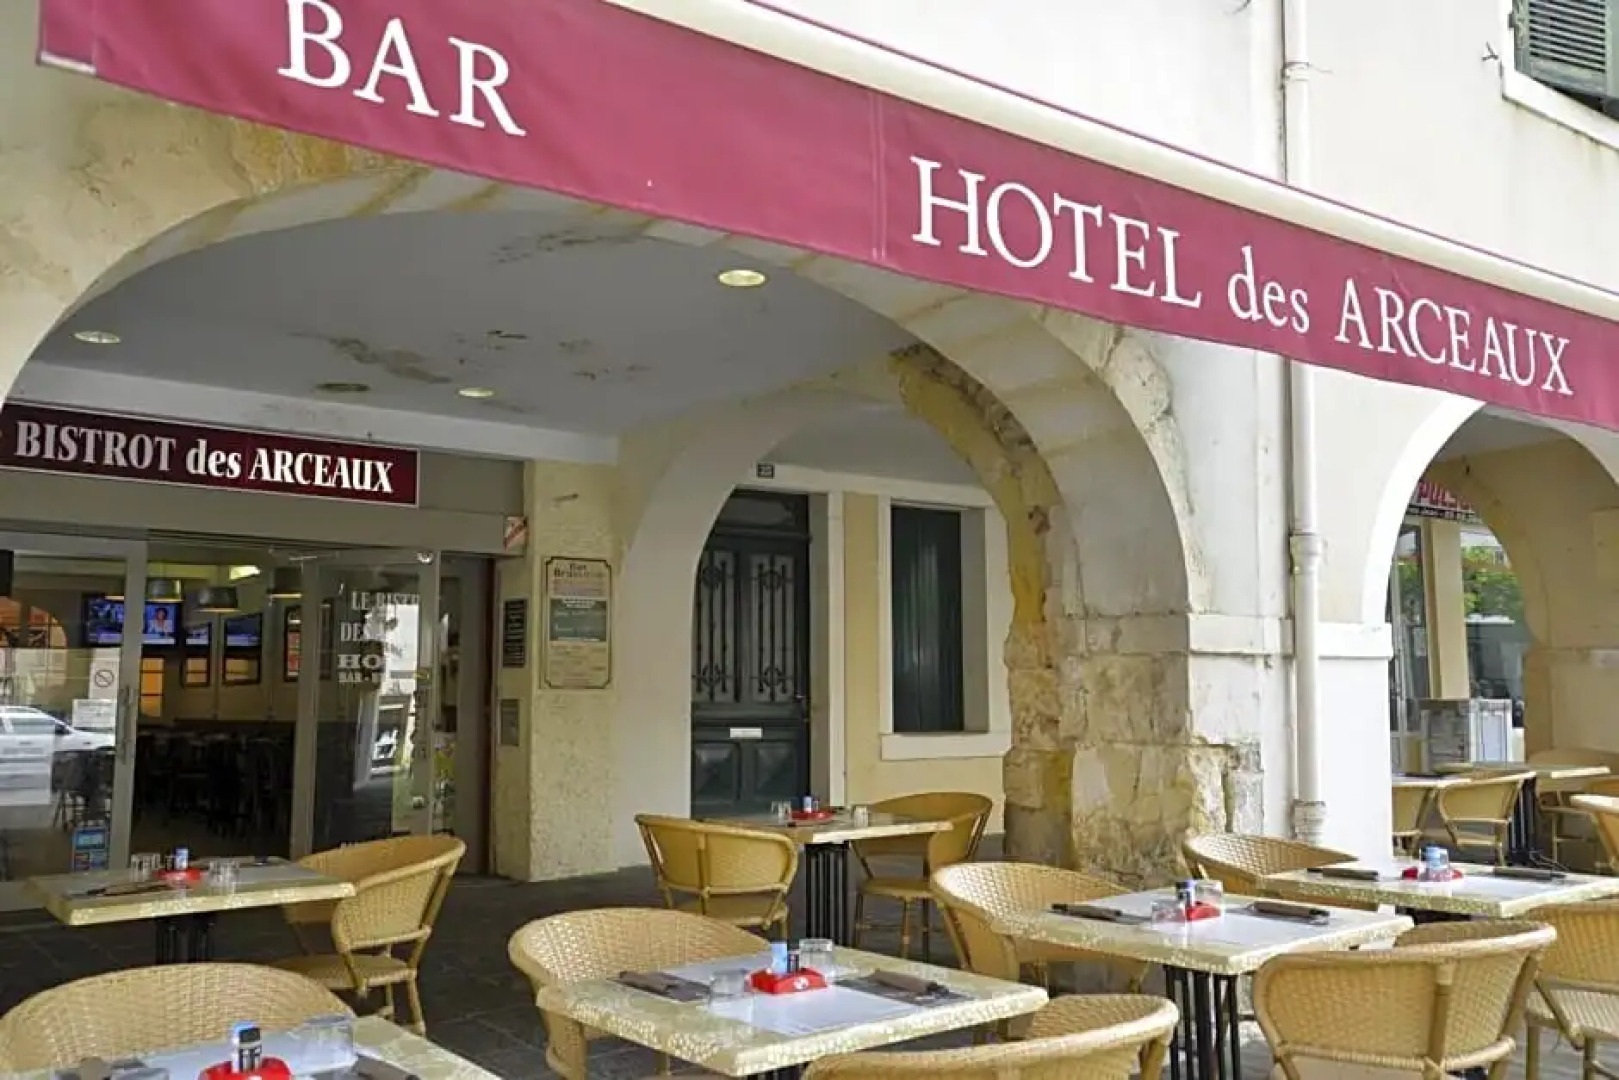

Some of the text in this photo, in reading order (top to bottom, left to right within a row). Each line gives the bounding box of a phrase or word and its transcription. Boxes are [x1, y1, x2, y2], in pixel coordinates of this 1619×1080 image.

[277, 0, 526, 137] BAR
[910, 155, 1574, 396] HOTEL des ARCEAUX
[14, 420, 394, 494] BISTROT des ARCEAUX
